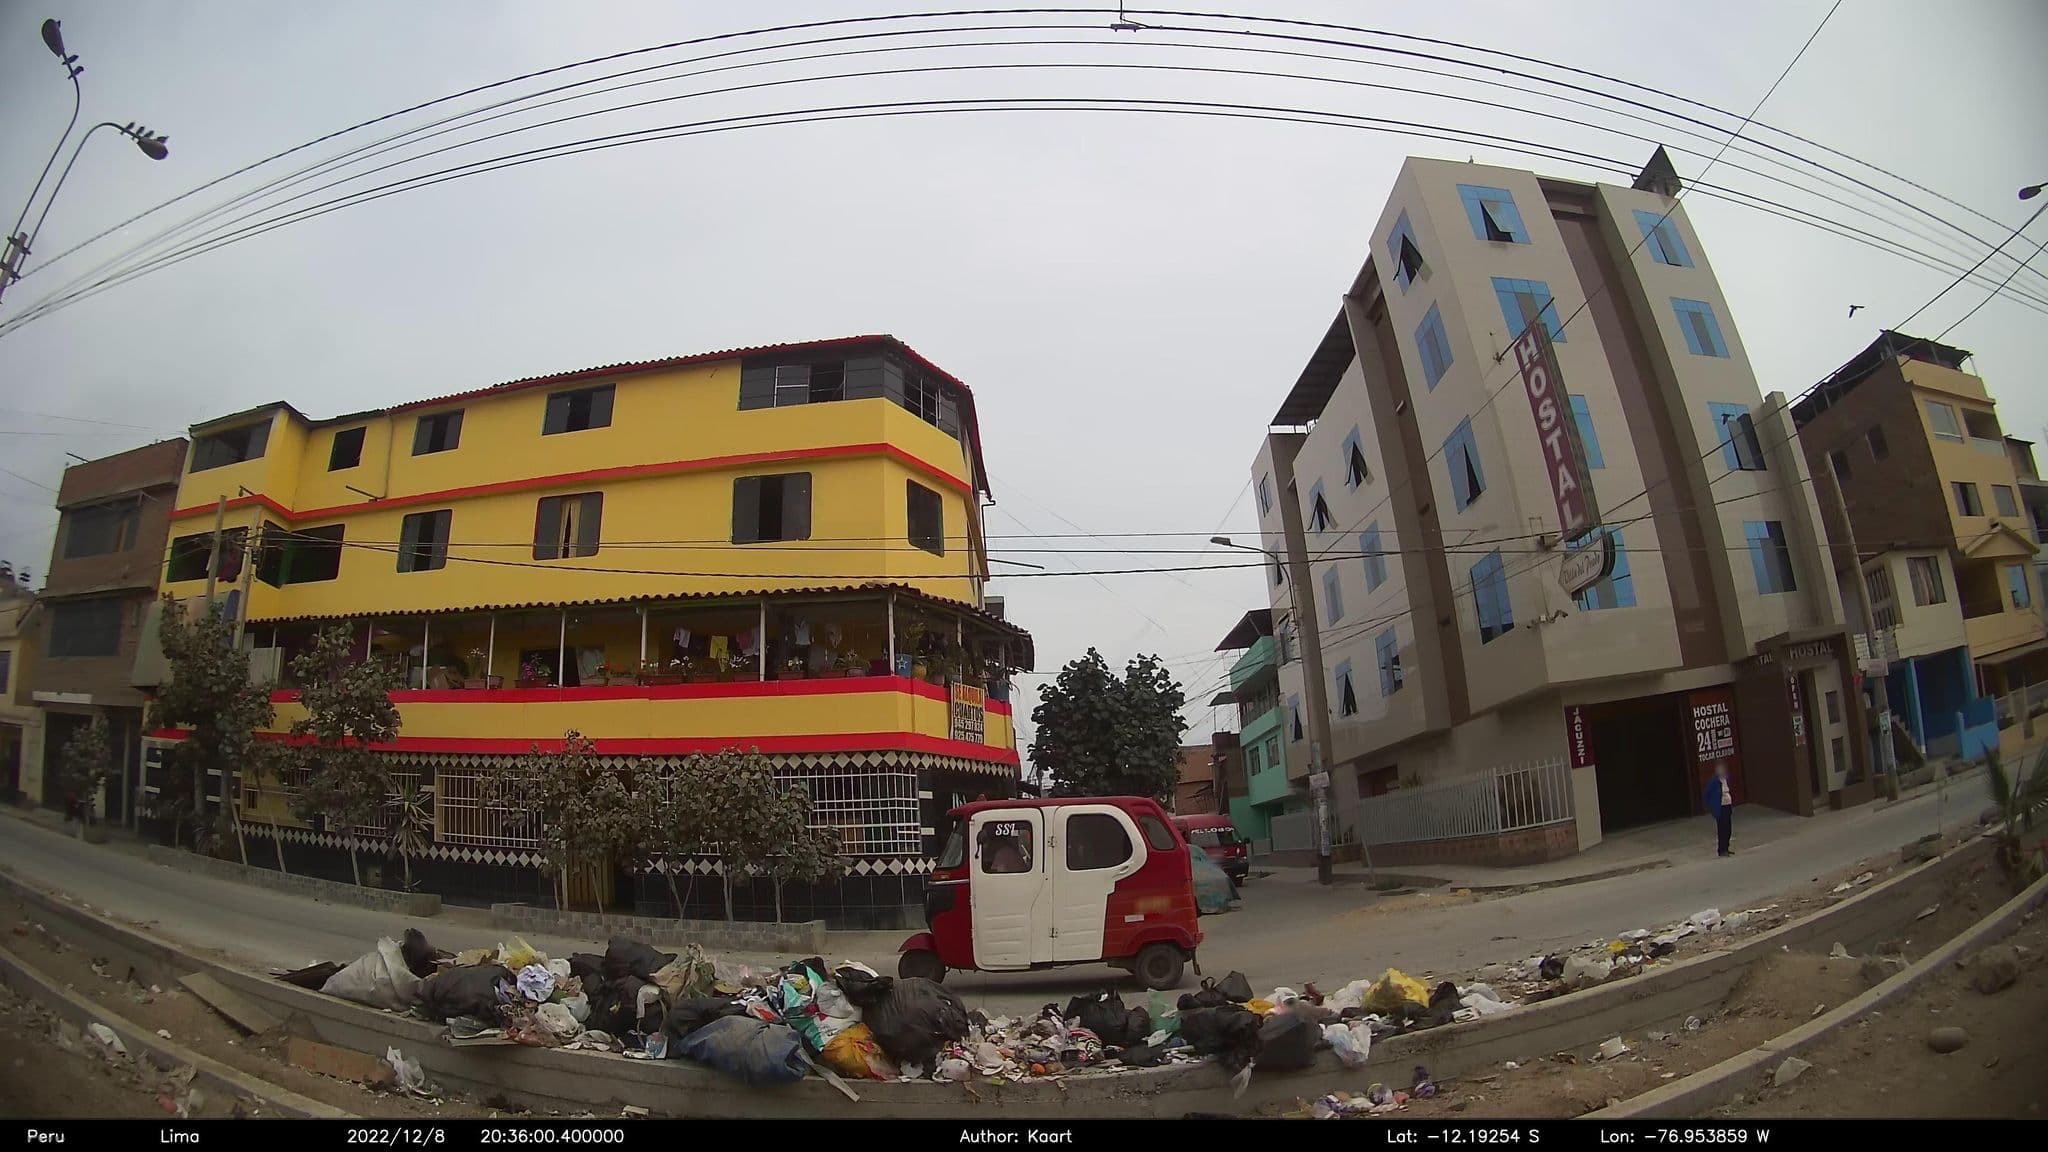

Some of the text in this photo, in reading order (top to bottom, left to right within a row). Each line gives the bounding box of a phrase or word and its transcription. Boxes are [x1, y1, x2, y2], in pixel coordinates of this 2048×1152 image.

[1519, 332, 1584, 529] HOSTAL
[1789, 640, 1834, 660] HOSTAL
[954, 701, 984, 722] CUARTOS
[1693, 702, 1729, 718] HOSTAL
[1694, 714, 1731, 731] COCHERA
[1573, 706, 1586, 765] JACUZZI
[1697, 731, 1712, 753] 24
